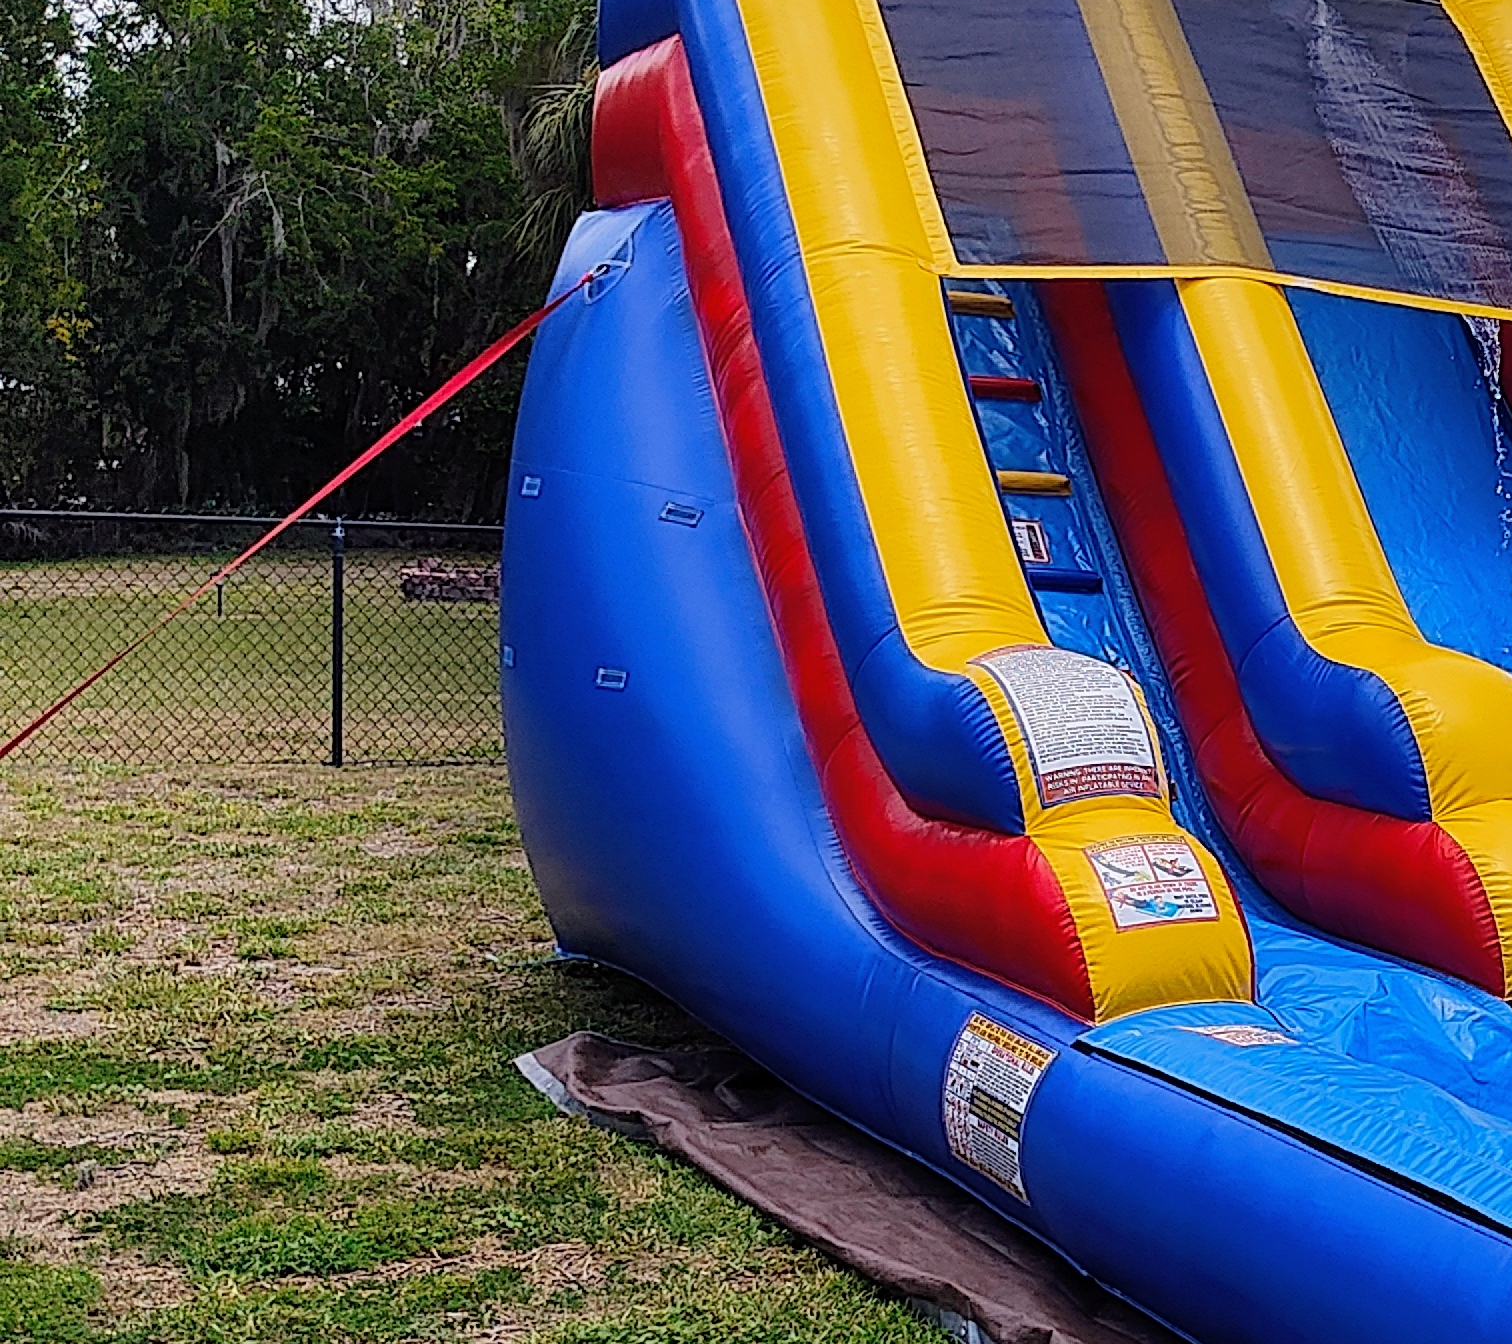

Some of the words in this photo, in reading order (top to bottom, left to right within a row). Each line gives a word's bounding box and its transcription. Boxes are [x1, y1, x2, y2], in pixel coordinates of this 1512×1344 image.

[1084, 765, 1106, 774] THERE
[1047, 780, 1069, 791] RISKS
[1069, 777, 1078, 785] IN
[1082, 772, 1132, 783] PARTICIPATING
[1063, 786, 1077, 795] AIR
[1078, 781, 1120, 792] INFLATABLE
